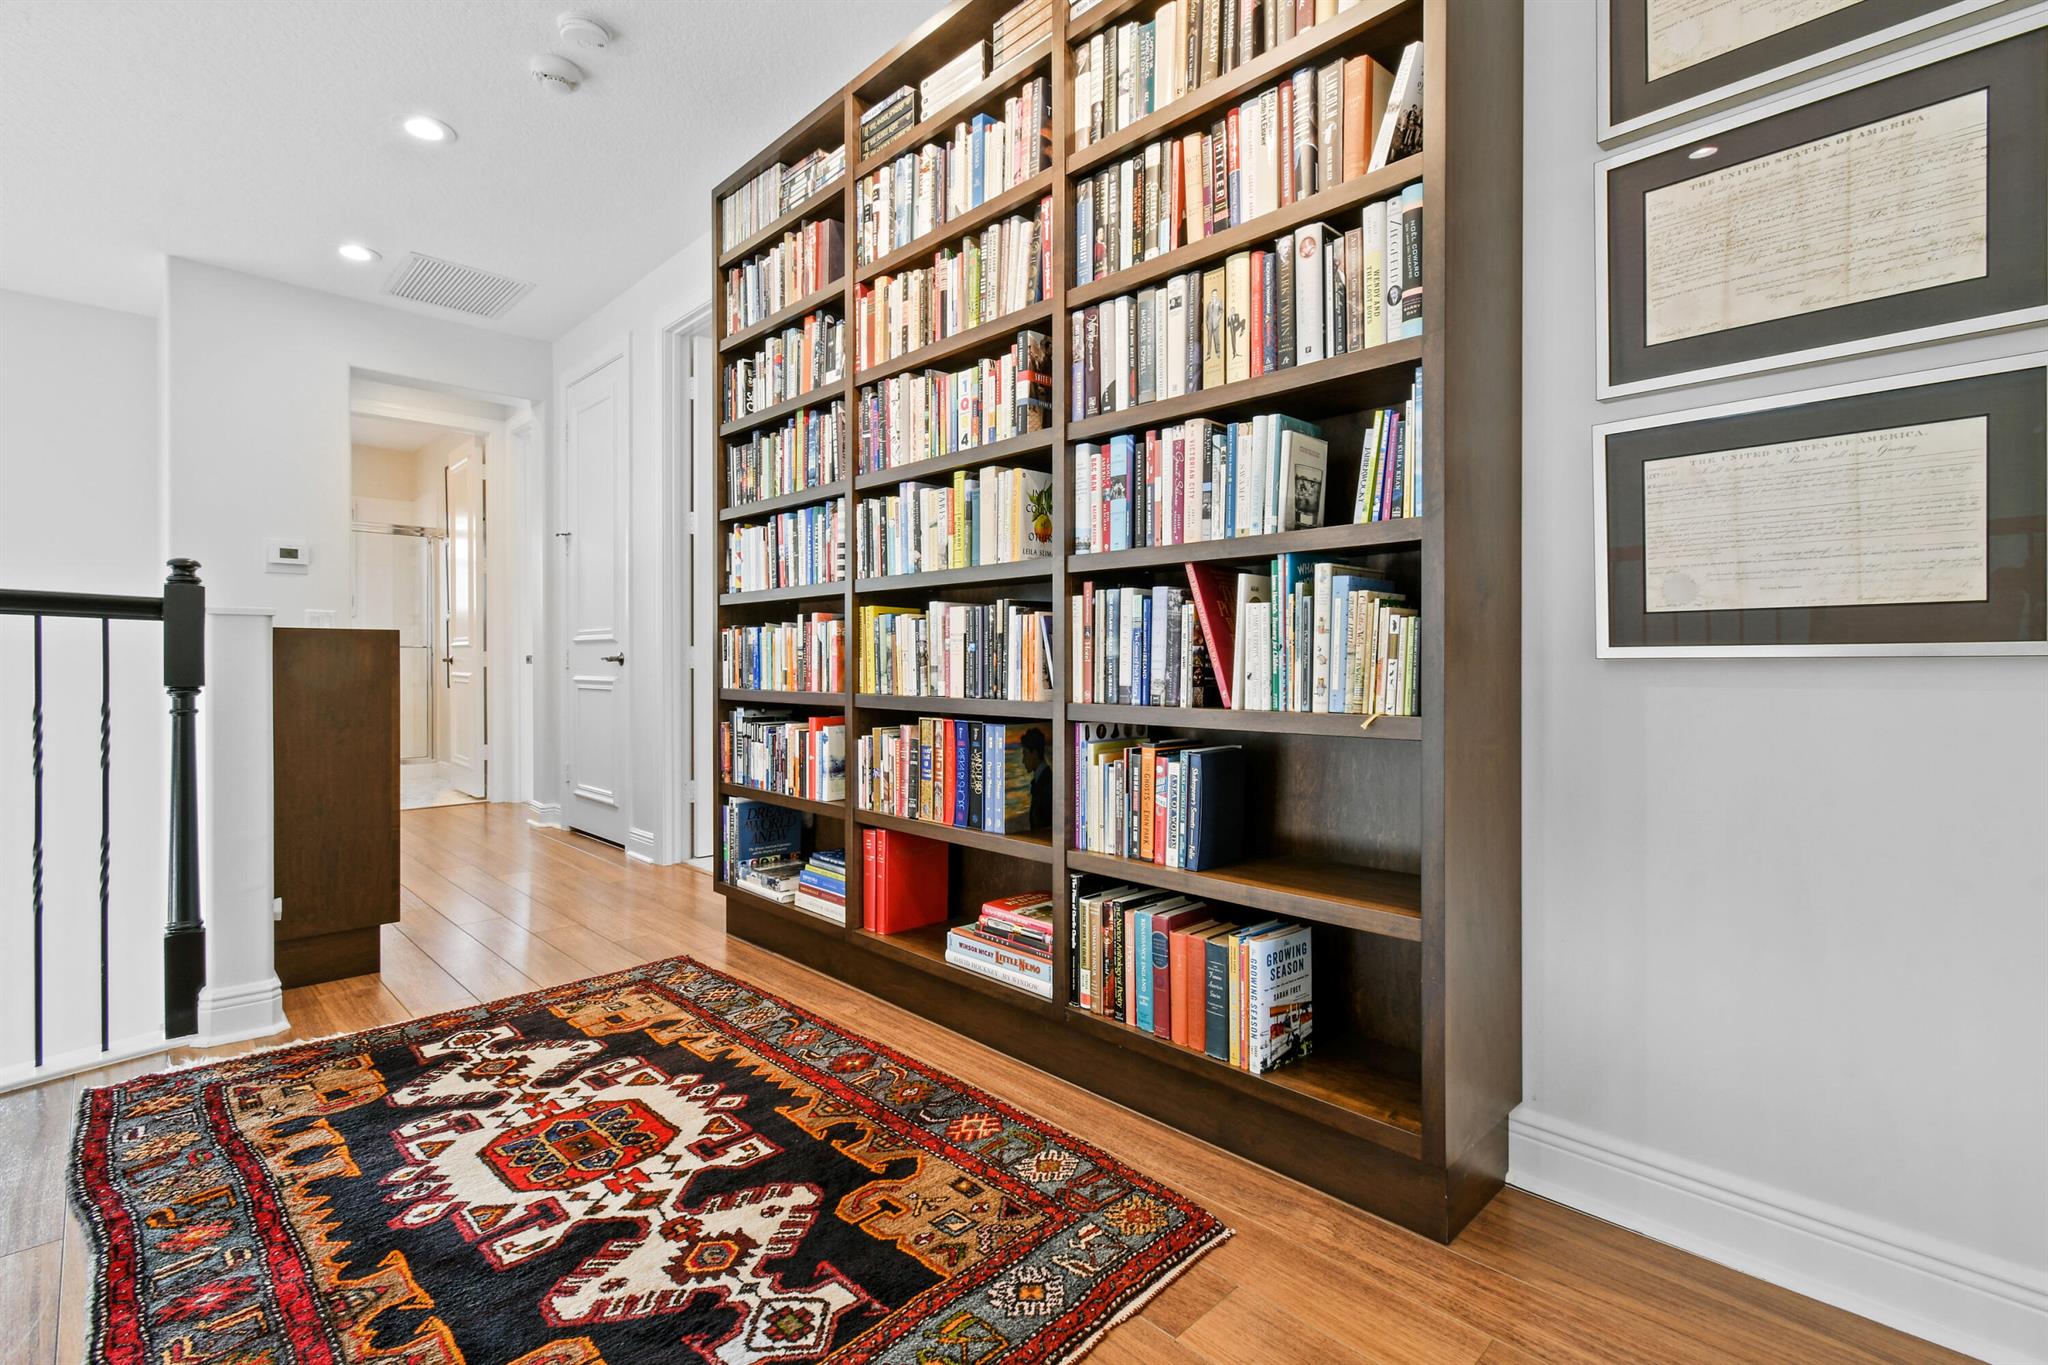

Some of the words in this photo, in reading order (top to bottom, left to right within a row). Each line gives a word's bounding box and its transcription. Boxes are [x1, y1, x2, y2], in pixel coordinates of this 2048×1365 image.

[1032, 83, 1040, 101] THIS
[1326, 71, 1339, 120] LINCOLN
[1031, 101, 1039, 135] TENDER
[1215, 143, 1226, 199] HITLER
[1689, 178, 1716, 191] THE
[1720, 160, 1771, 187] UNITED
[1775, 142, 1832, 169] STATES
[1836, 136, 1852, 147] OF
[1149, 182, 1159, 231] GALILEO'S
[1411, 243, 1420, 279] COWARD
[1280, 263, 1291, 294] MARK
[1373, 268, 1381, 292] WENDY
[1281, 296, 1292, 338] TWAIN
[1174, 452, 1184, 477] Great
[1396, 445, 1404, 469] KUBLA
[1689, 457, 1717, 466] THE
[1720, 450, 1771, 465] UNITED
[1775, 442, 1829, 456] STATES
[1834, 438, 1851, 448] OF
[1091, 475, 1099, 492] MAN
[1358, 447, 1371, 504] JABBERWOCKY
[939, 491, 947, 523] PARIS
[1022, 547, 1037, 556] LEILA
[1190, 767, 1199, 806] Shakespeare's
[1170, 815, 1178, 850] WORDS
[1071, 888, 1079, 903] Films
[1071, 909, 1079, 929] Charlie
[1070, 929, 1079, 950] Chaplin
[1140, 917, 1148, 960] RENAISSANCE
[958, 942, 978, 953] WINSOR
[994, 950, 1018, 966] LITTLE
[1018, 959, 1041, 974] NEMO
[1114, 942, 1124, 975] Anthology
[1266, 942, 1307, 968] GROWING
[1250, 957, 1258, 1002] GROWING
[1270, 961, 1305, 982] SEASON
[1115, 983, 1124, 1008] Poetry
[1273, 989, 1289, 1002] SARAH
[1289, 985, 1302, 997] FREY
[1250, 1003, 1258, 1040] SEASON
